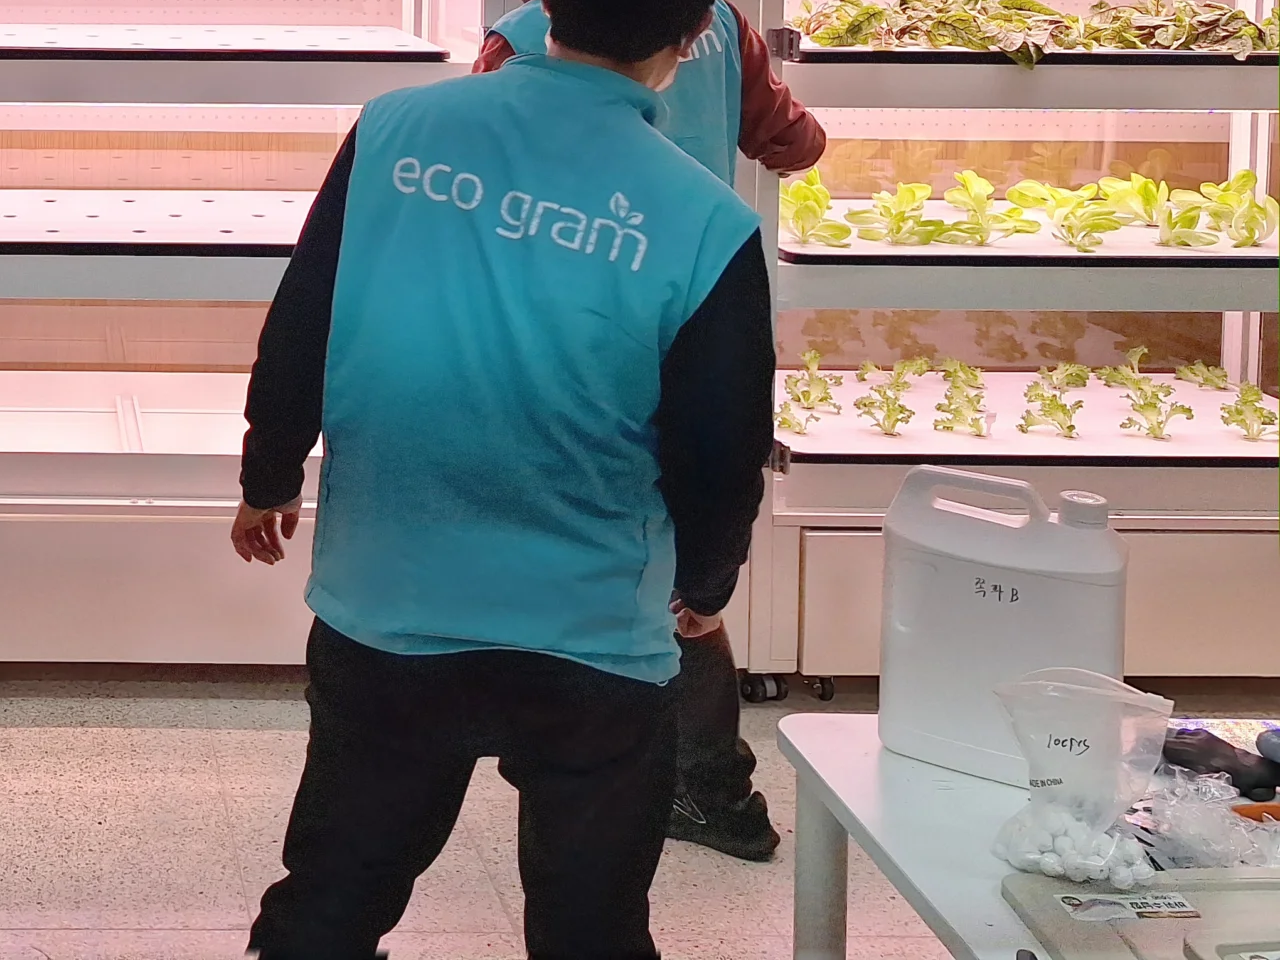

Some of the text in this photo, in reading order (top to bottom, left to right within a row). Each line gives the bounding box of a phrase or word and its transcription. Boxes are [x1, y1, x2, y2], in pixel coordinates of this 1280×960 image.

[392, 156, 649, 272] eco gram
[1009, 587, 1019, 604] B
[1046, 777, 1064, 786] CHINA
